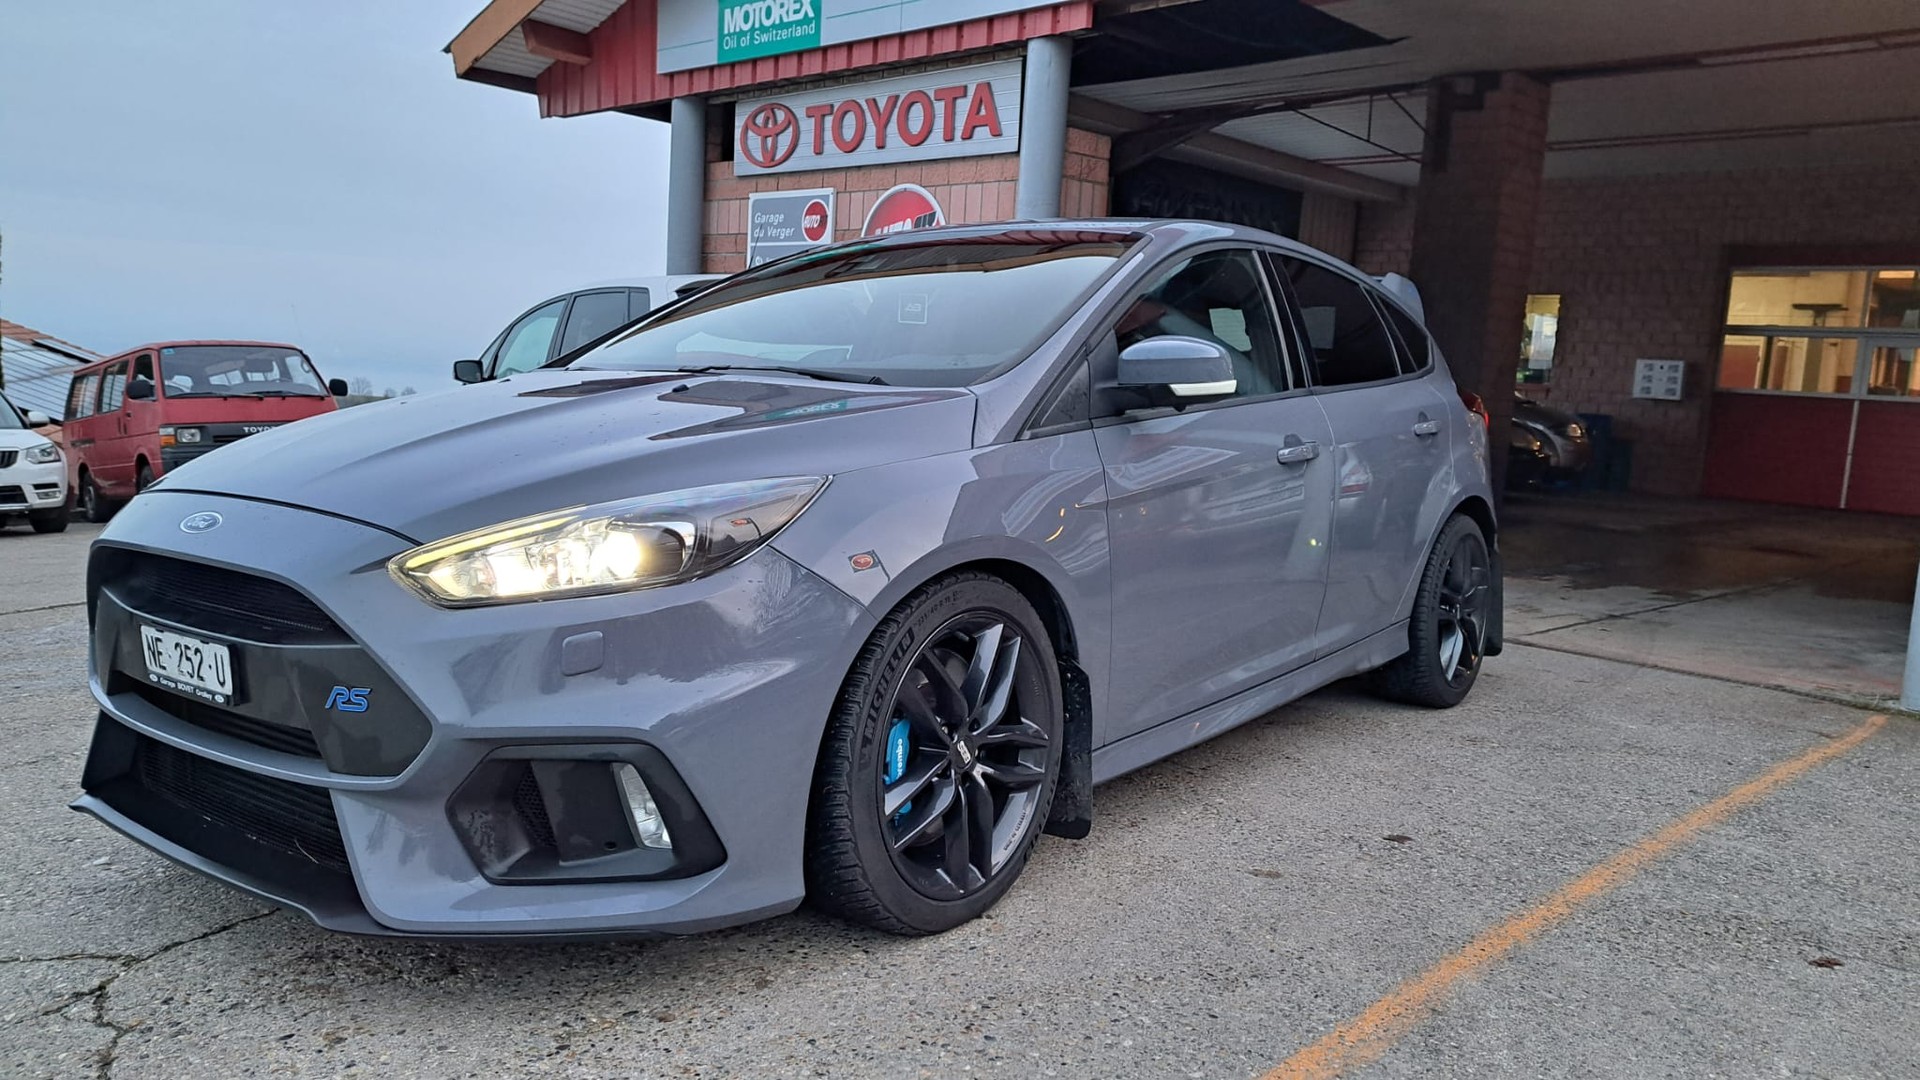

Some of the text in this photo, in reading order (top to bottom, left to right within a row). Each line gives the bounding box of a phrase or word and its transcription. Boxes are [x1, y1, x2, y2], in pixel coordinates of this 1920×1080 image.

[724, 0, 815, 34] MOTOREX
[723, 20, 816, 50] Oil of Switzerland
[806, 82, 1003, 155] TOYOTA
[753, 226, 796, 239] du Verger
[754, 212, 785, 226] Garage
[804, 214, 821, 229] AUTO
[144, 634, 167, 670] NE
[325, 686, 371, 712] RS
[863, 630, 913, 739] MICHELIN
